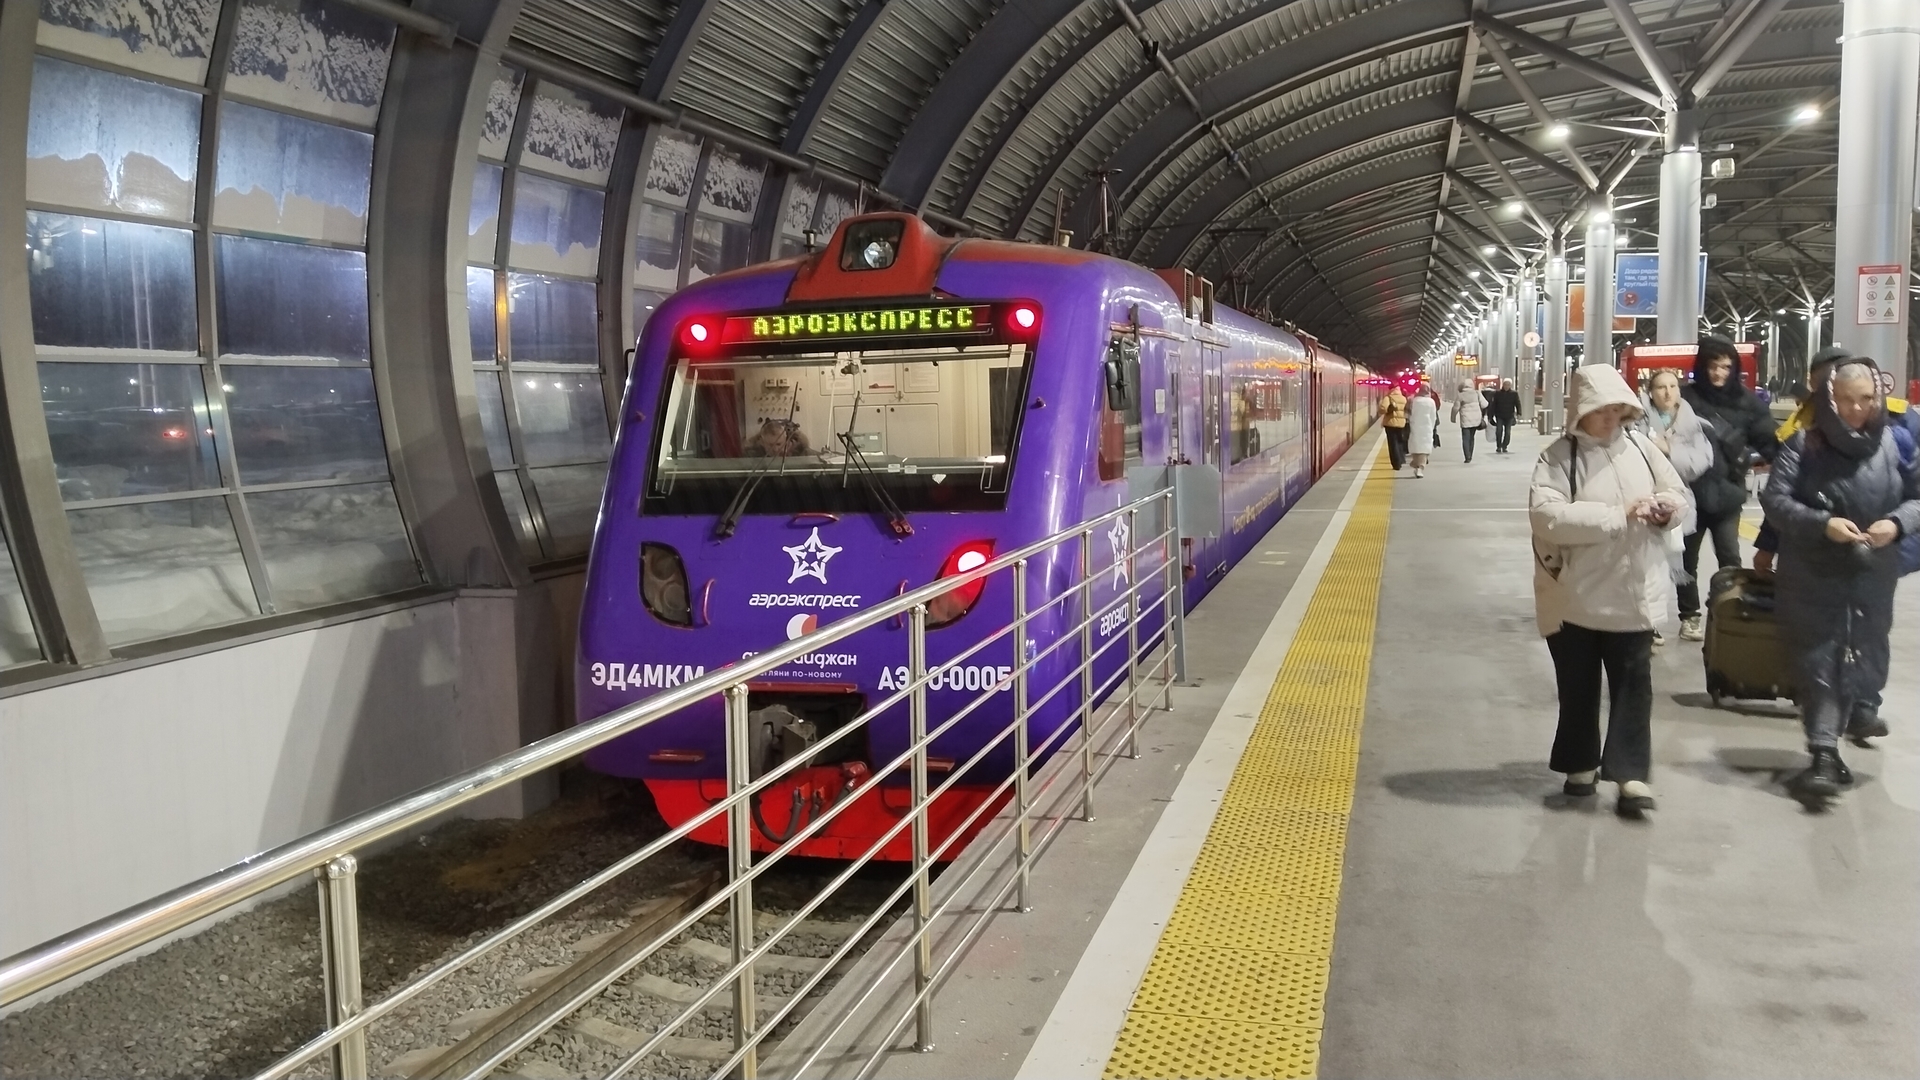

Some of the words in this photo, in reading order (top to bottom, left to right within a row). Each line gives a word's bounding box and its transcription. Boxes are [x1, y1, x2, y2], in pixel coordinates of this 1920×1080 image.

[753, 307, 973, 336] АЭРОЭКСПРЕСС
[748, 593, 862, 610] аэроэкспресс
[591, 662, 704, 691] ЭД4МКМ
[877, 665, 1012, 691] АЭО-0005
